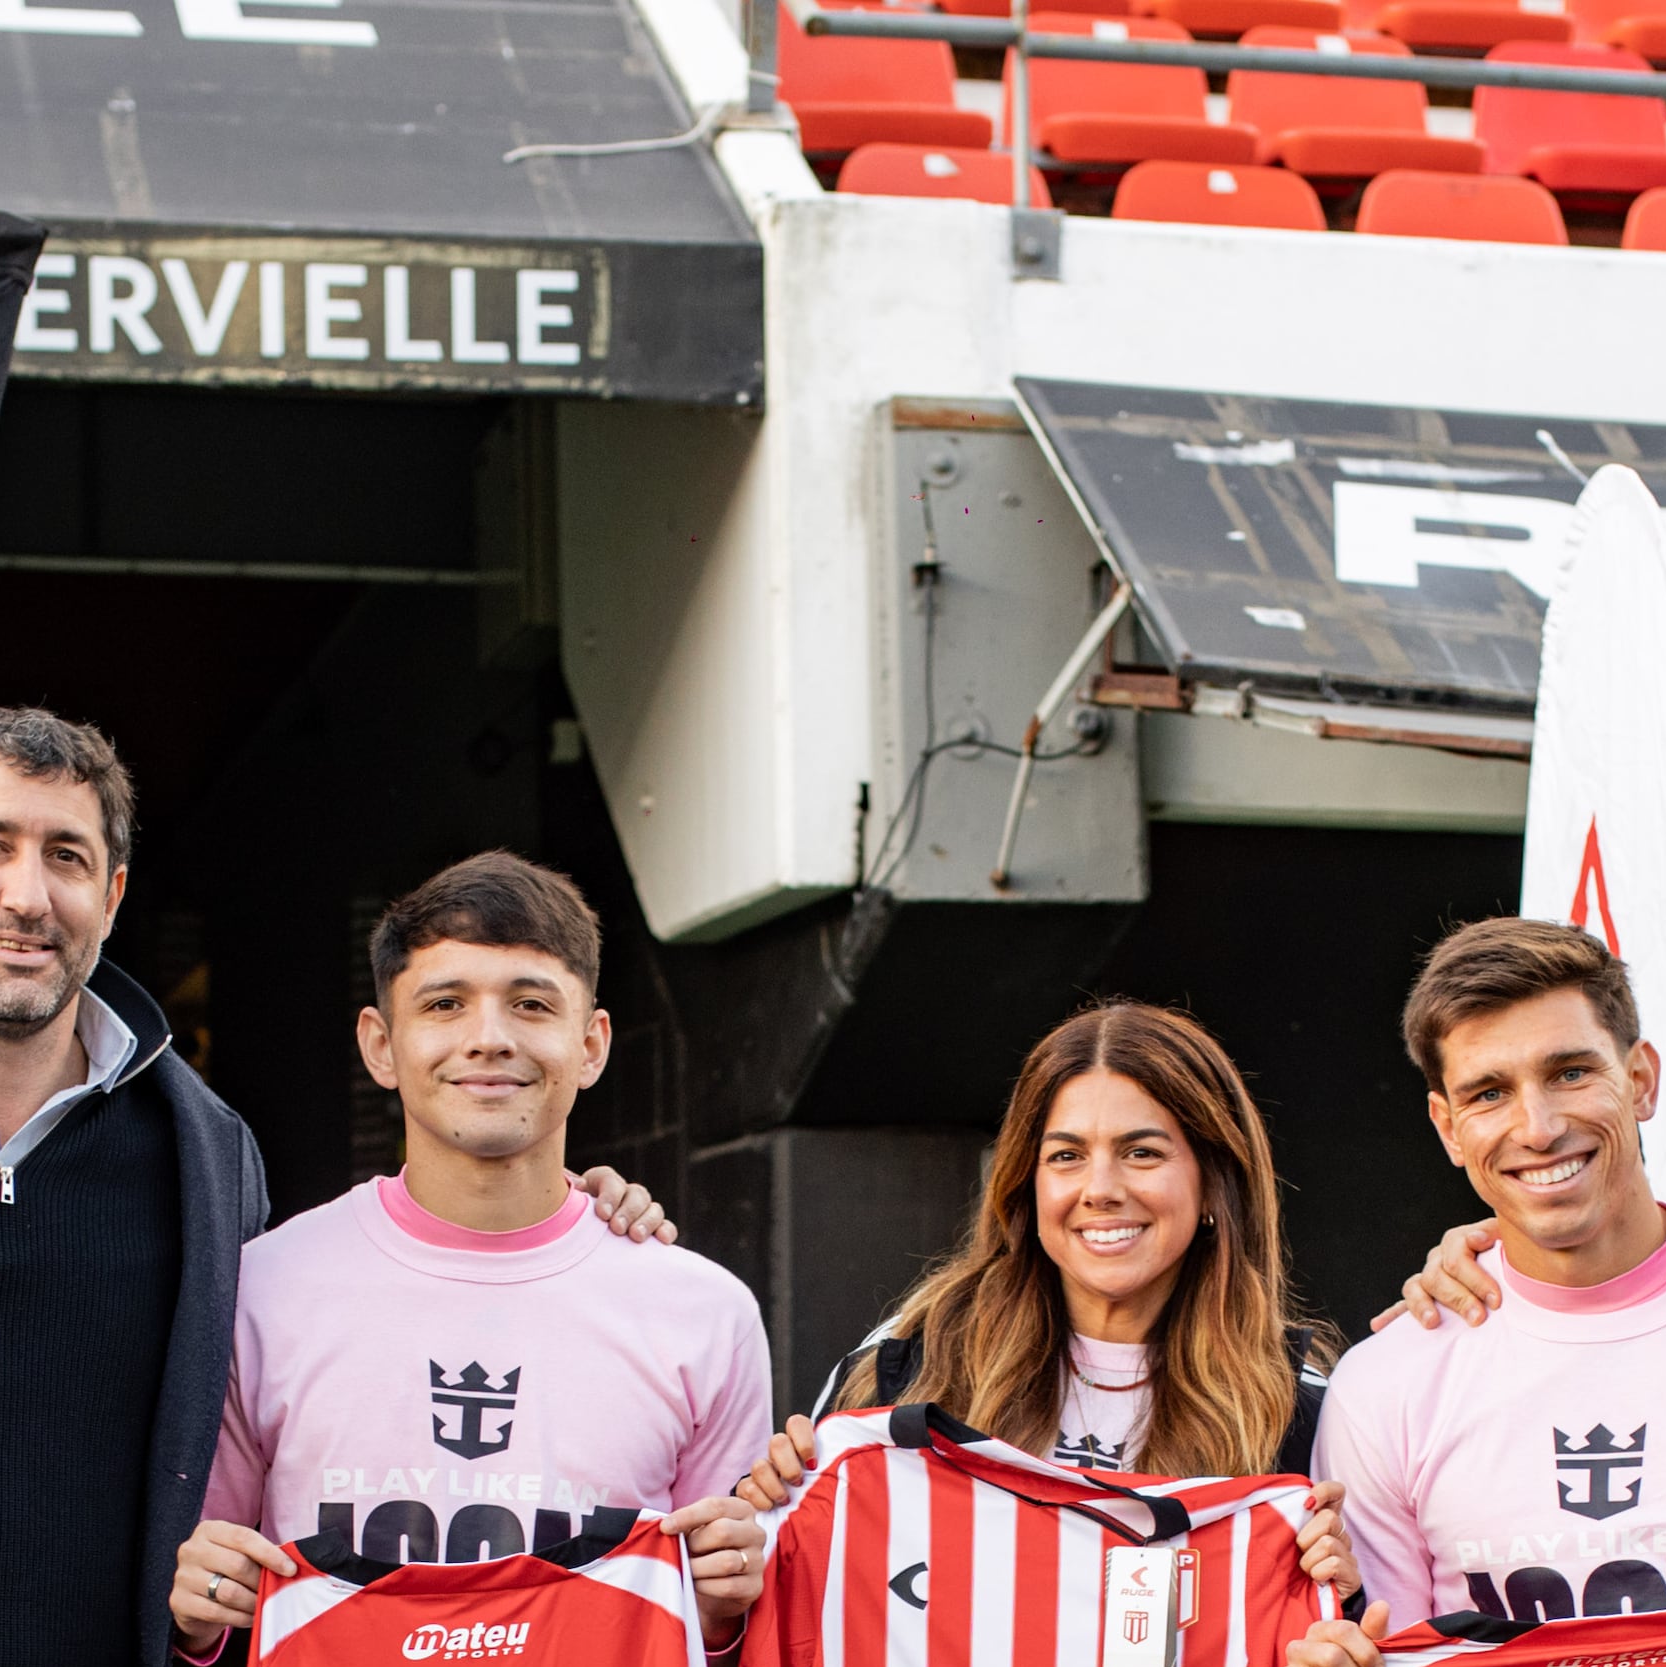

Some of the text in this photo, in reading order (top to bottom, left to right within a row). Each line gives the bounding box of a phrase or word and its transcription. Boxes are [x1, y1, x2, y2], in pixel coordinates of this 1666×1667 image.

[323, 1467, 611, 1507] PLAY LIKE AN
[1456, 1533, 1563, 1566] PLAY
[401, 1622, 531, 1660] mateu
[443, 1646, 524, 1660] SPORTS
